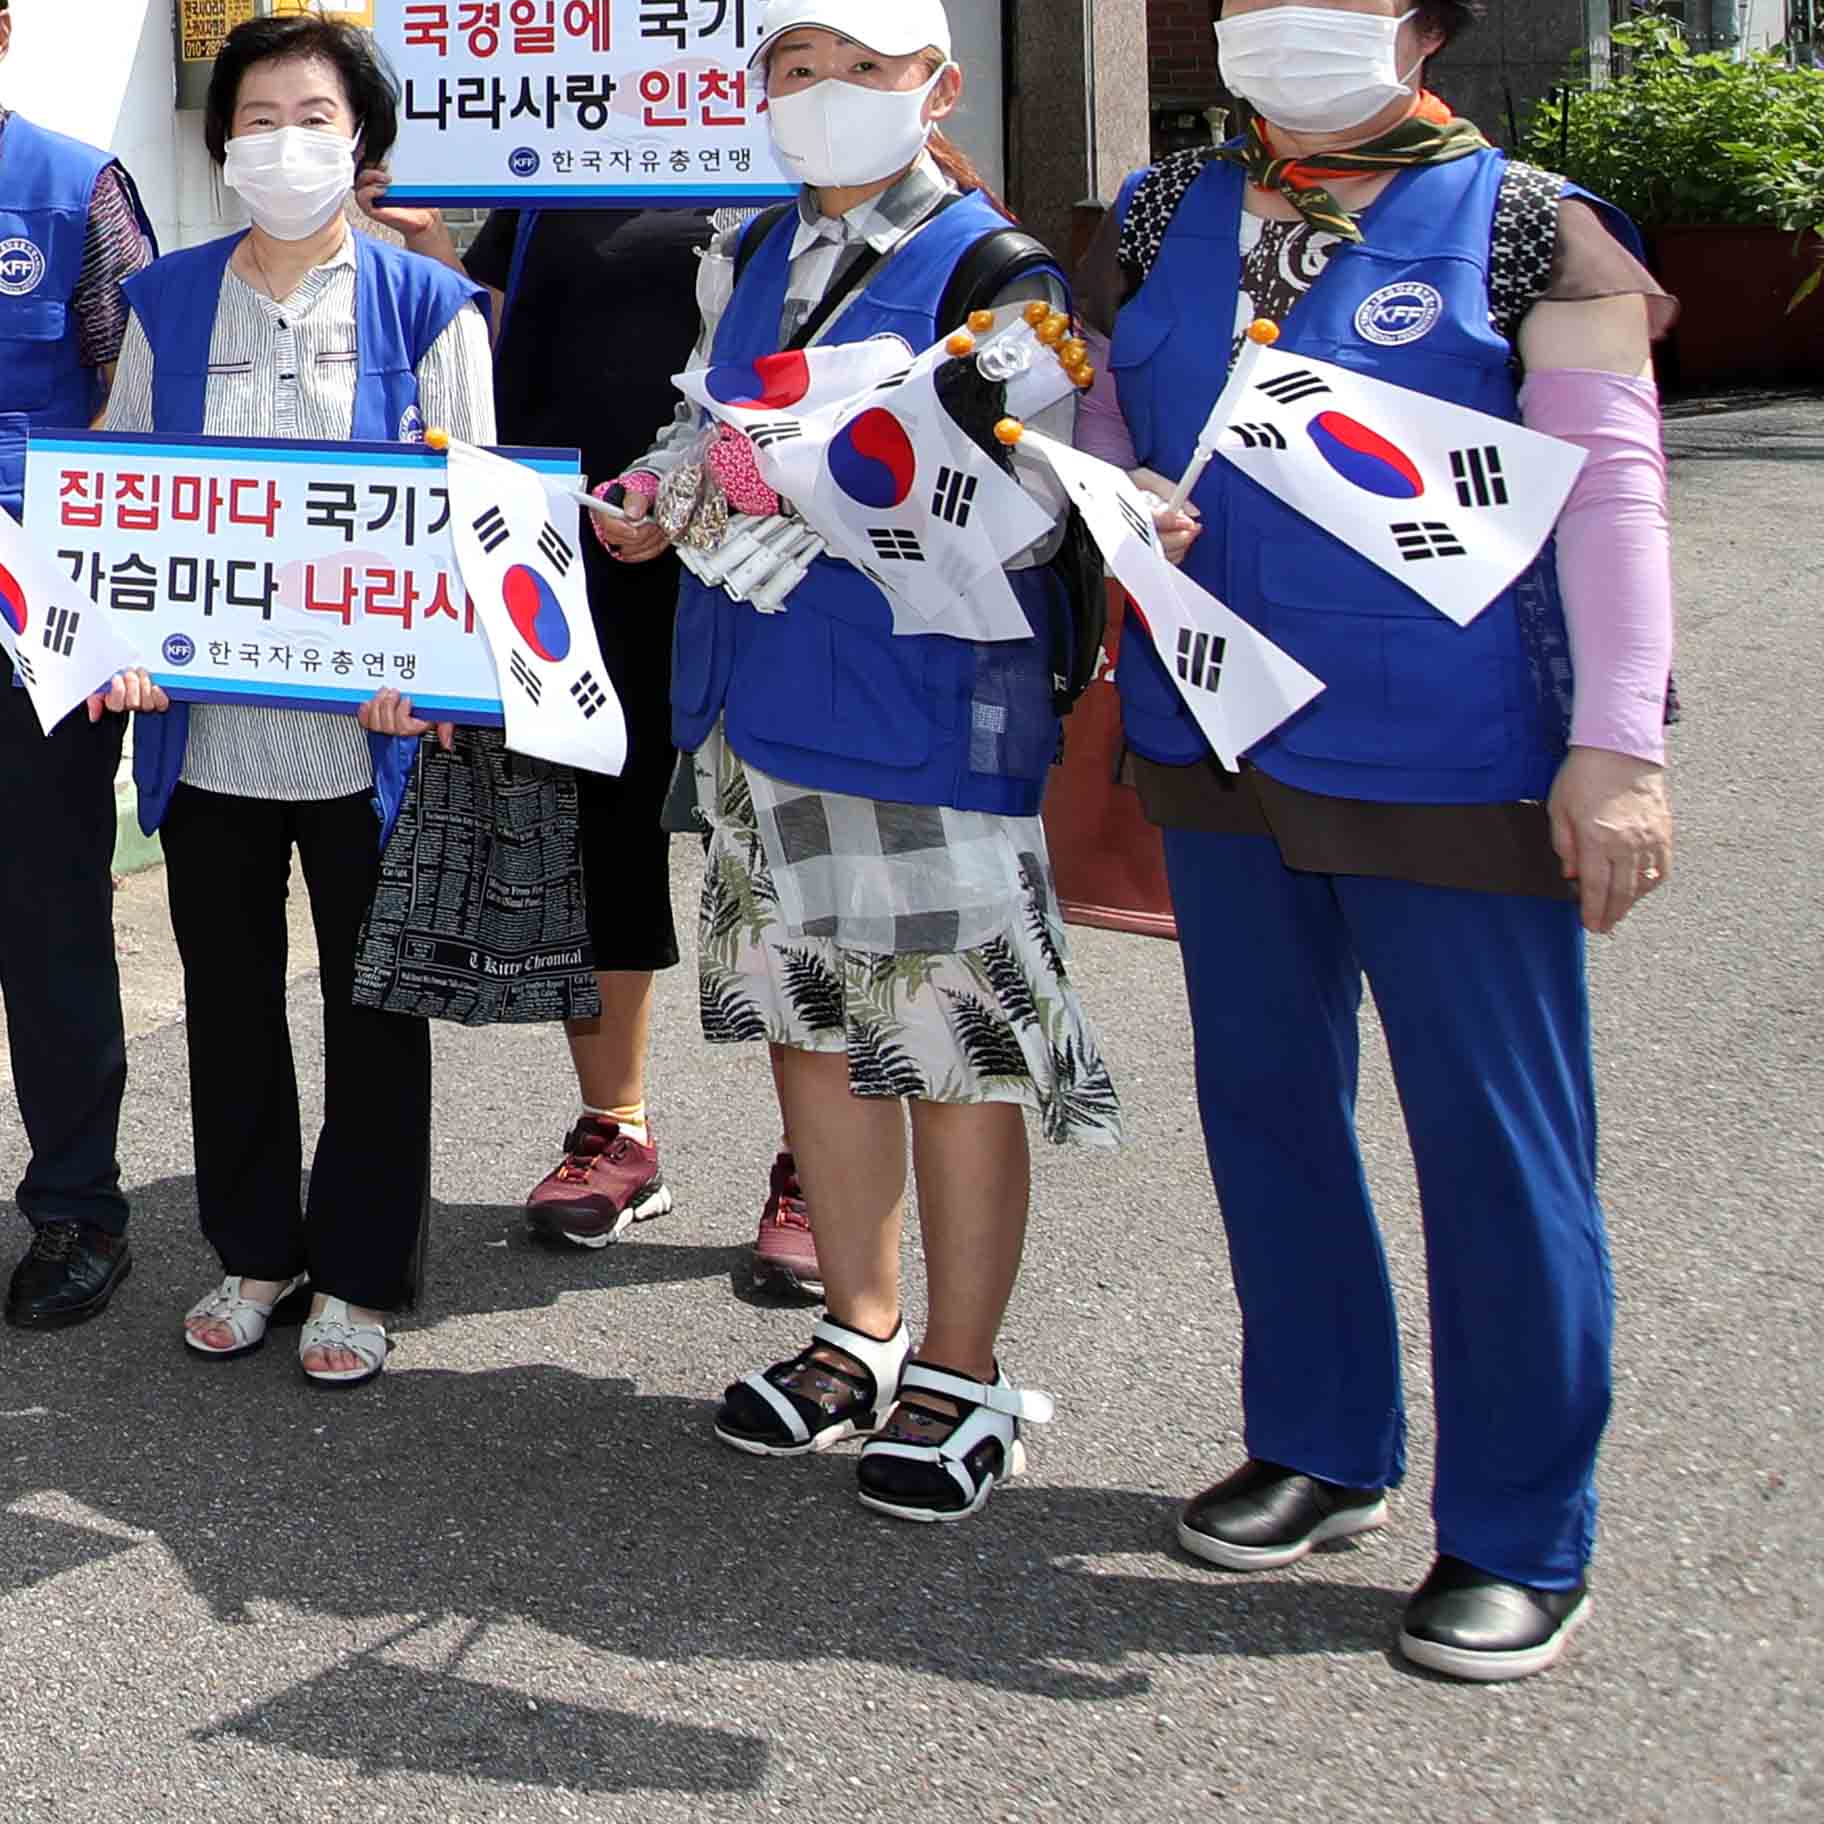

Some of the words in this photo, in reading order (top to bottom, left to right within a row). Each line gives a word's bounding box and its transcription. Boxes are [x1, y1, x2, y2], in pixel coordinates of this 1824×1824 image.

[404, 73, 617, 132] 나라사랑
[638, 68, 770, 130] 인천
[551, 148, 752, 174] 한국자유총연맹
[59, 469, 282, 538] 집집마다
[305, 480, 452, 547] 국기
[305, 563, 476, 634] 나라사
[208, 640, 418, 680] 한국자유총연맹
